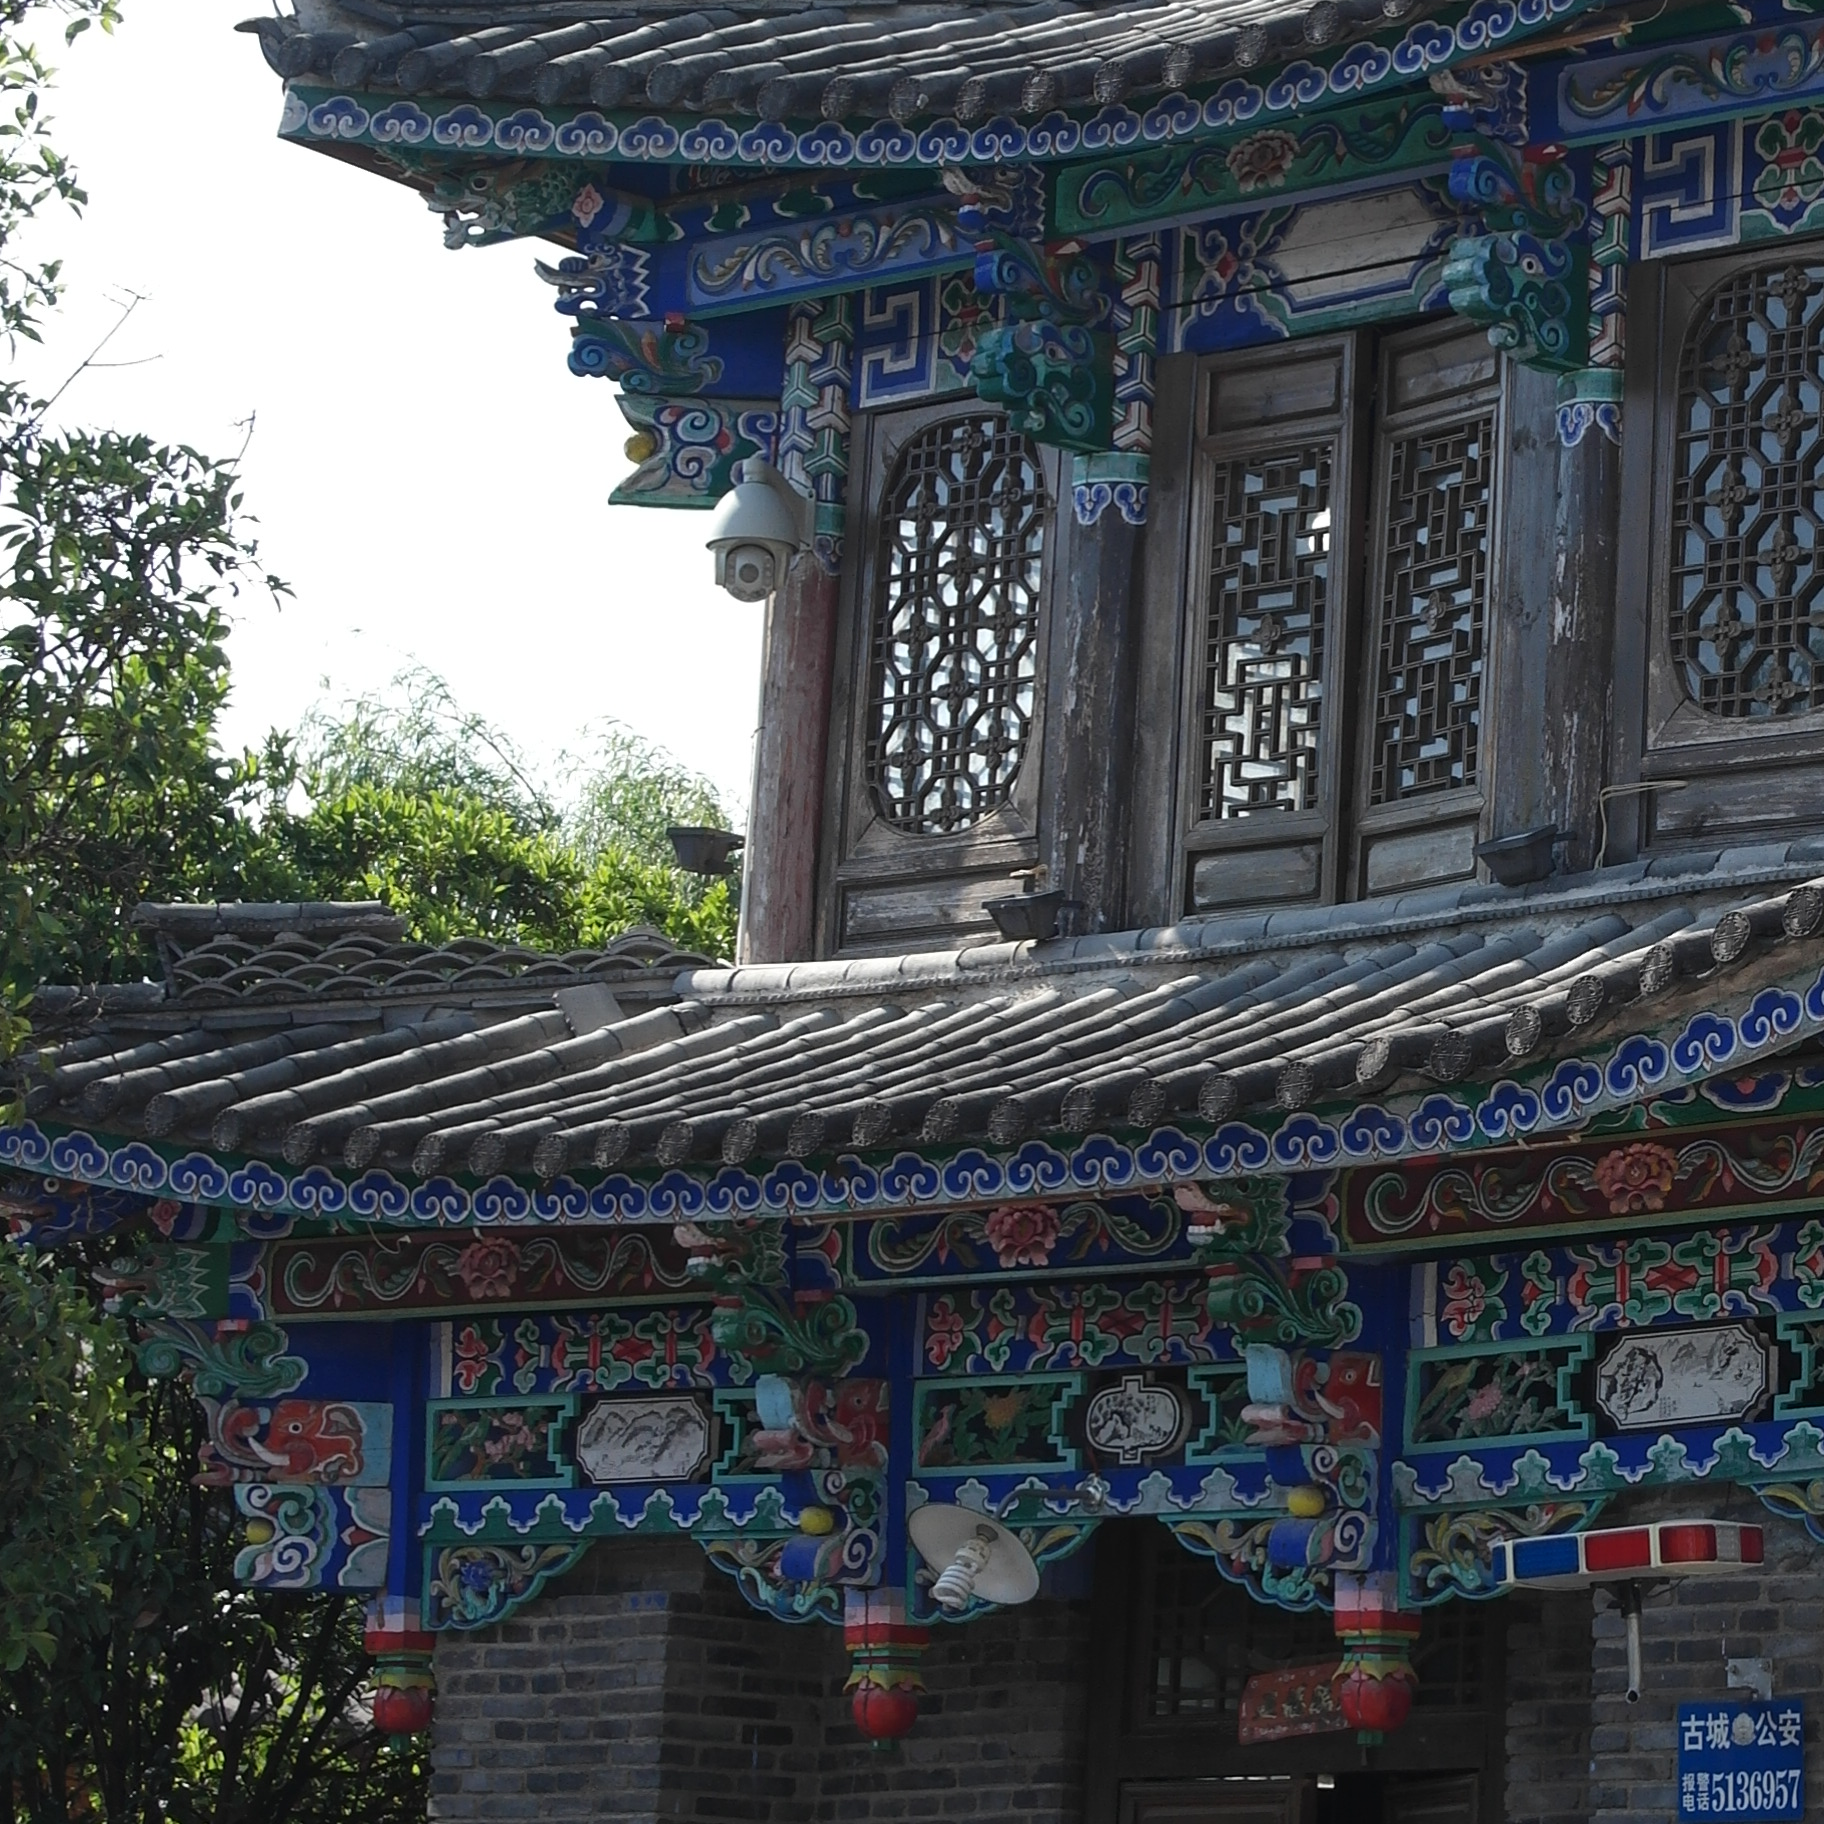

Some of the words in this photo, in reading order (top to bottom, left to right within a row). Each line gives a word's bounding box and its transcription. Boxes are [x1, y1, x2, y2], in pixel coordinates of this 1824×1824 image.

[1681, 1712, 1731, 1751] 古城
[1755, 1708, 1802, 1746] 公安
[1682, 1772, 1710, 1793] 报警
[1712, 1769, 1802, 1812] 5136957
[1682, 1793, 1710, 1812] 电话
